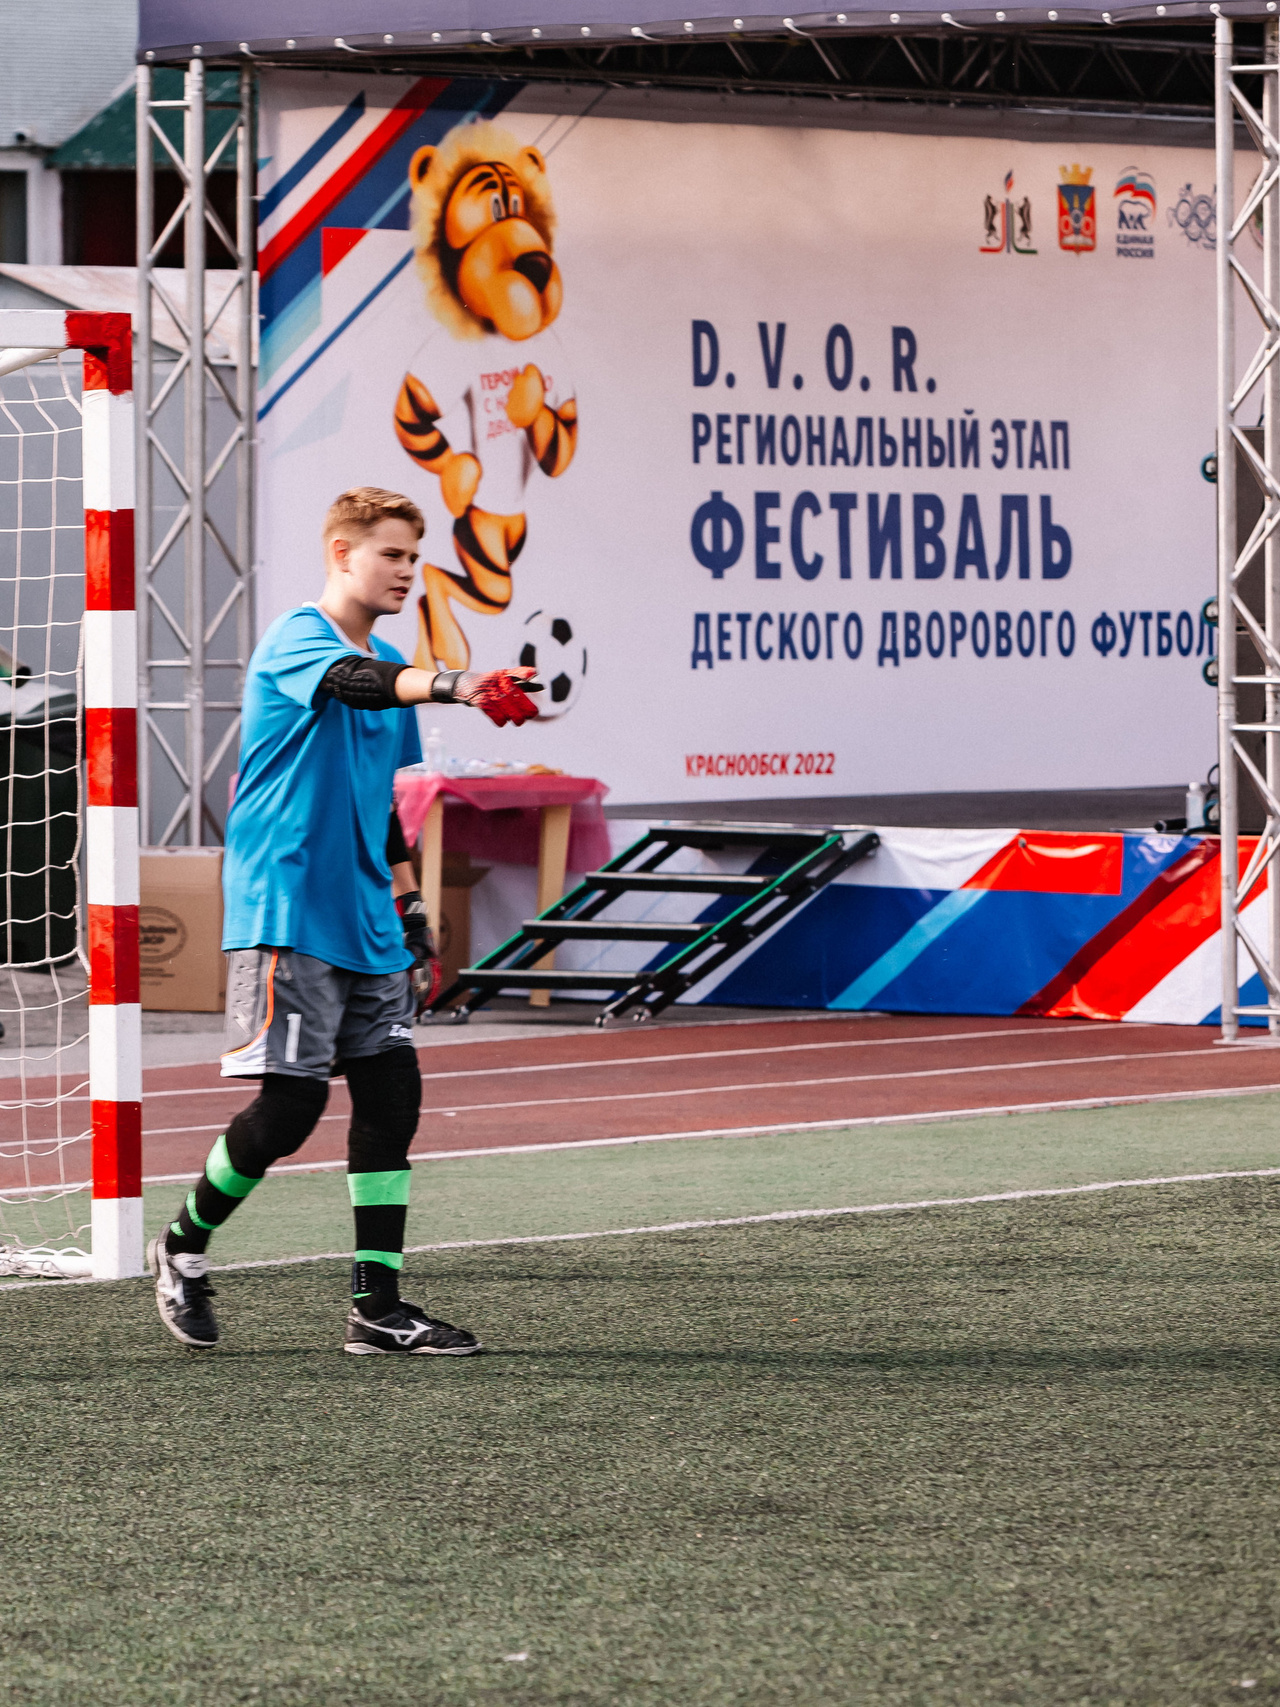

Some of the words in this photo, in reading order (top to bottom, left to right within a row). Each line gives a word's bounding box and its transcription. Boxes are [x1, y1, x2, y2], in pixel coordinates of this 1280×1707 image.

[1116, 247, 1154, 258] РОССИЯ
[692, 319, 735, 388] D.
[758, 321, 803, 390] V.
[825, 323, 870, 392] O.
[892, 326, 936, 393] R.
[692, 409, 980, 468] РЕГИОНАЛЬНЫЙ
[991, 419, 1070, 470] ЭТАП
[690, 491, 1072, 580] ФЕСТИВАЛЬ
[691, 612, 863, 669] ДЕТСКОГО
[878, 611, 1075, 667] ДВОРОВОГО
[686, 753, 790, 776] КРАСНООБСК
[794, 753, 835, 775] 2022
[285, 1013, 302, 1063] 1
